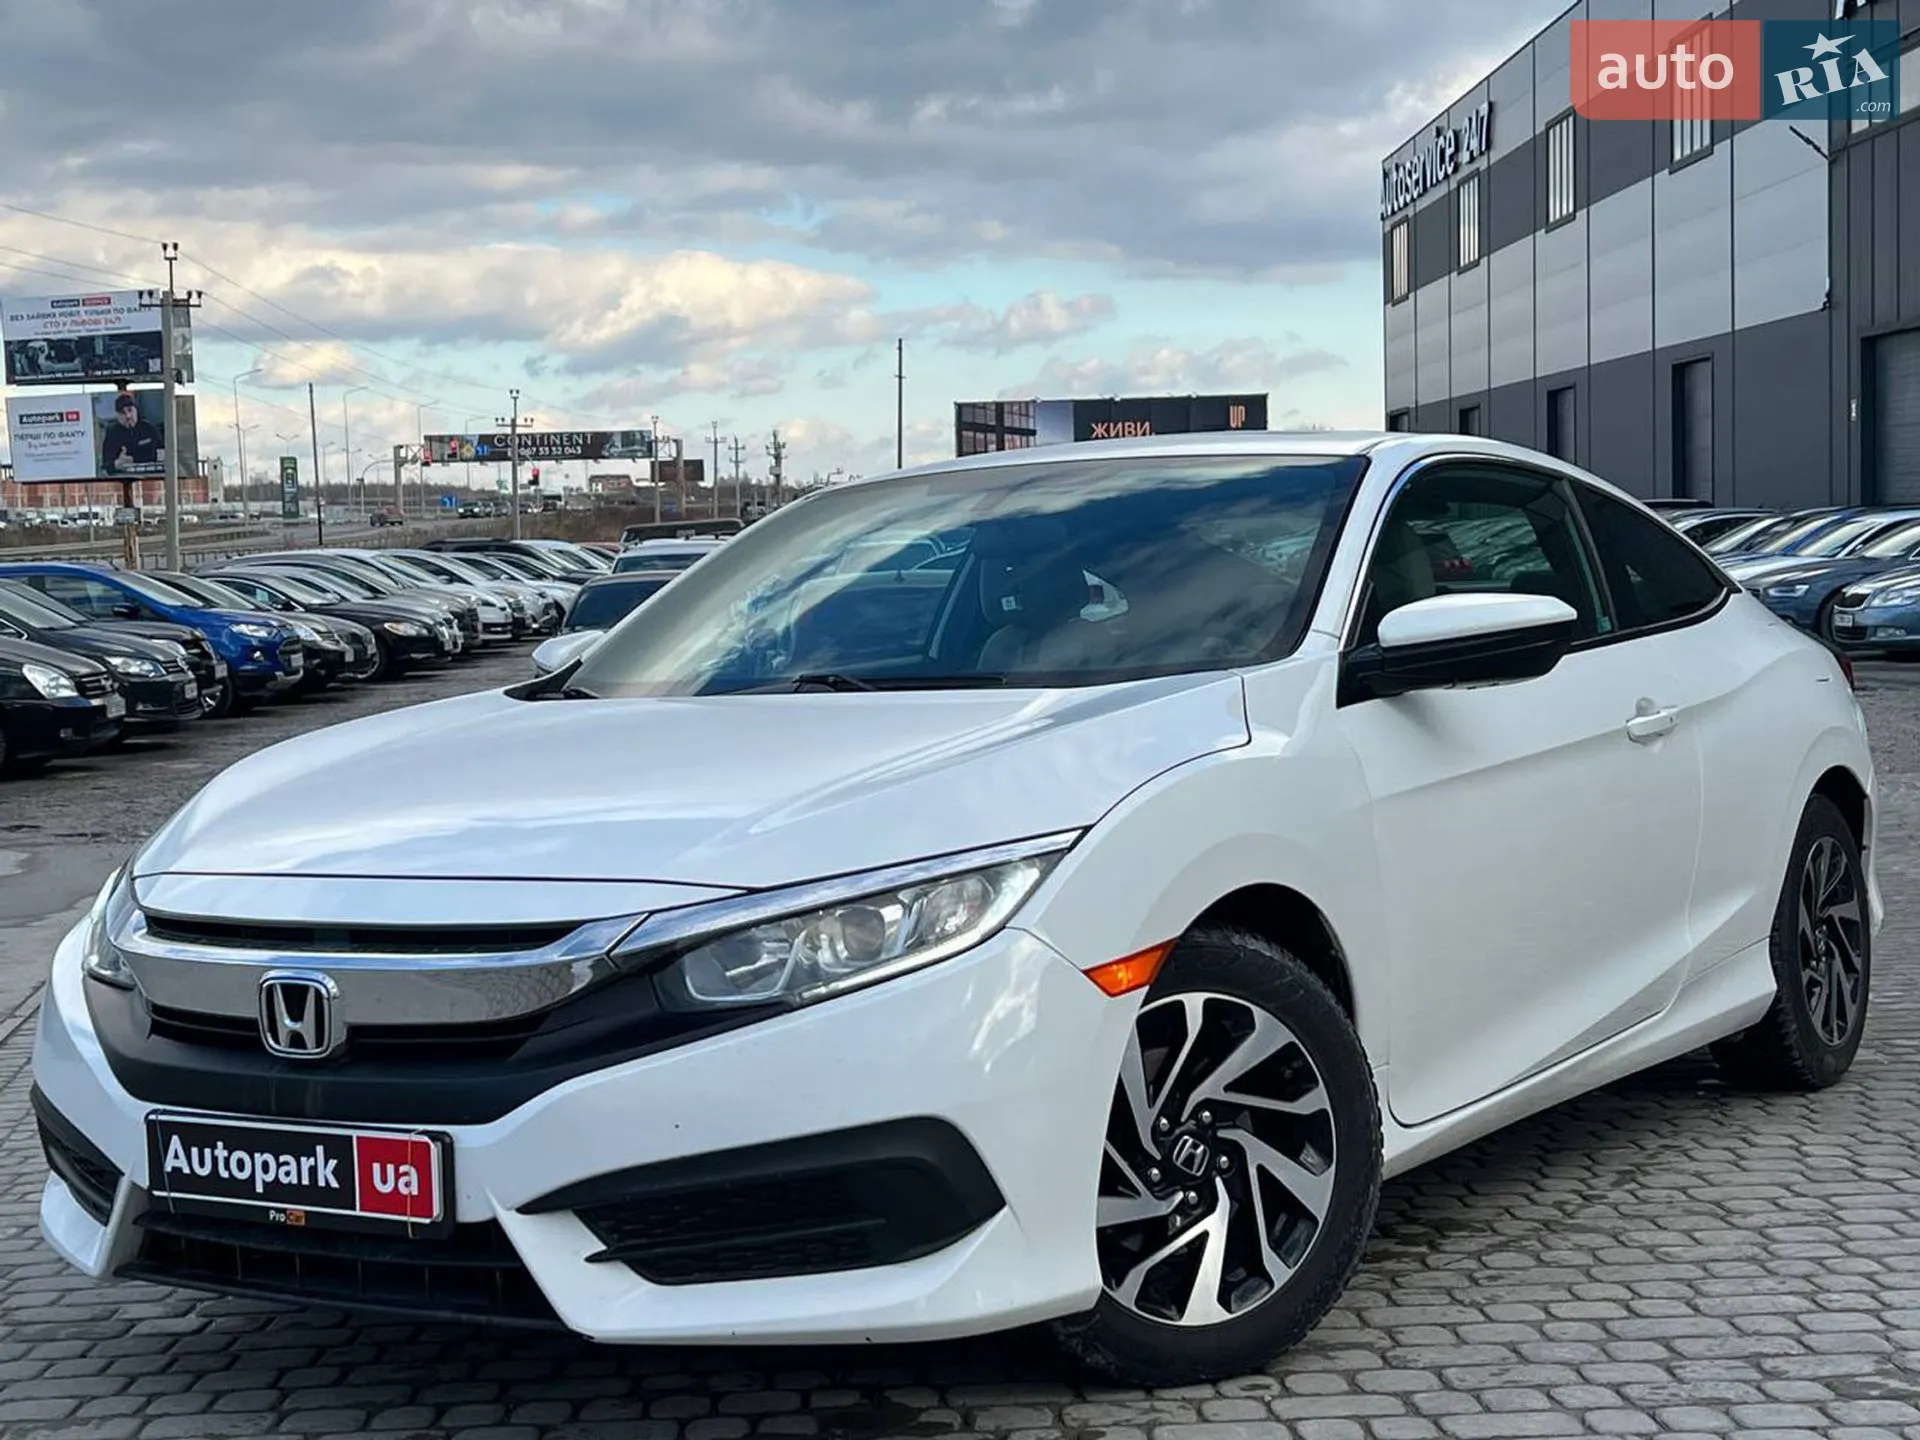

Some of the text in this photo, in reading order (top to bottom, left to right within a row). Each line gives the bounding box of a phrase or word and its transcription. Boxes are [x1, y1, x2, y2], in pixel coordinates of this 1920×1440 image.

[493, 432, 592, 447] CONTINENT
[164, 1134, 419, 1196] Autopark ua
